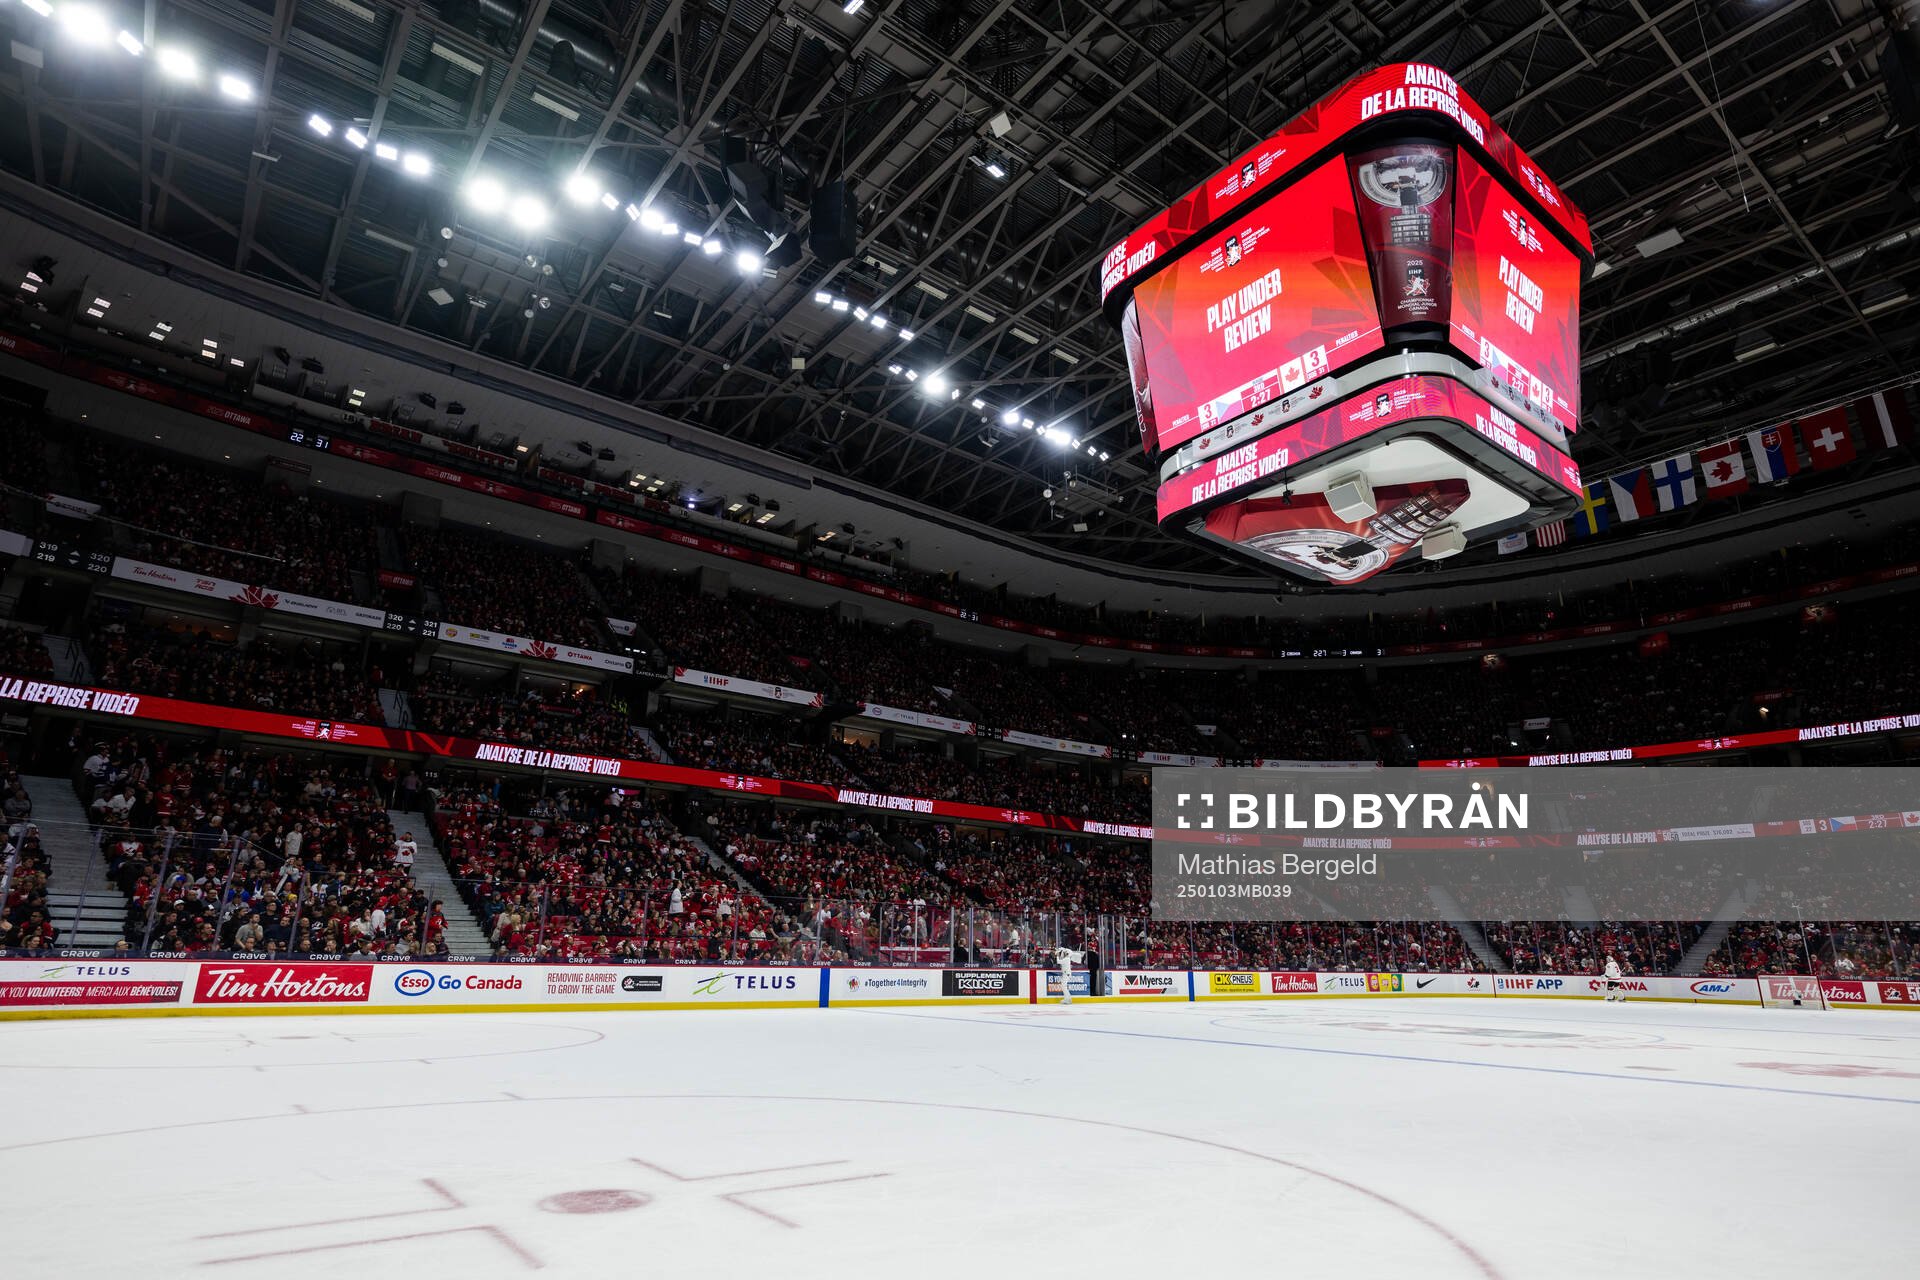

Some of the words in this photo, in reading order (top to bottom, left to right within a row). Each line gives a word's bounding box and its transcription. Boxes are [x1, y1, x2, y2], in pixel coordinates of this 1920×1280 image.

[1405, 64, 1459, 101] ANALYSE
[1361, 93, 1382, 120] DE
[1386, 88, 1406, 111] LA
[1409, 87, 1460, 122] REPRISE
[1460, 107, 1484, 145] VIDÉO
[1127, 240, 1156, 276] VIDÉO
[1499, 255, 1520, 292] PLAY
[1518, 271, 1543, 314] UNDER
[1207, 293, 1237, 333] PLAY
[1238, 268, 1282, 315] UNDER
[1506, 290, 1534, 335] REVIEW
[1224, 304, 1272, 353] REVIEW
[1310, 350, 1320, 368] 3
[1251, 389, 1272, 409] 2:27
[224, 410, 251, 426] OTTAWA
[1204, 403, 1213, 420] 3
[290, 433, 304, 443] 22
[315, 439, 329, 449] 31
[1215, 442, 1259, 477] ANALYSE
[1192, 484, 1204, 504] DE
[1205, 479, 1217, 500] LA
[1217, 461, 1258, 495] REPRISE
[1258, 447, 1289, 478] VIDÉO
[39, 541, 59, 552] 319
[36, 552, 56, 563] 219
[90, 552, 110, 563] 320
[87, 562, 108, 573] 220
[387, 612, 404, 622] 320
[423, 619, 438, 629] 321
[385, 622, 402, 632] 220
[421, 629, 437, 638] 221
[567, 651, 593, 661] OTTAWA
[708, 676, 729, 687] IIHF
[0, 677, 24, 700] LA
[22, 681, 94, 710] REPRISE
[92, 693, 140, 716] VIDÉO
[1799, 725, 1838, 741] ANALYSE
[1837, 722, 1850, 737] DE
[1850, 721, 1864, 735] LA
[1863, 715, 1902, 733] REPRISE
[475, 743, 525, 765] ANALYSE
[523, 749, 539, 766] DE
[537, 751, 552, 768] LA
[550, 753, 592, 773] REPRISE
[592, 758, 621, 777] VIDÉO
[1529, 754, 1560, 767] ANALYSE
[1559, 753, 1570, 765] DE
[1570, 752, 1580, 764] LA
[1579, 750, 1611, 763] REPRISE
[1610, 747, 1633, 761] VIDÉO
[838, 789, 869, 806] ANALYSE
[868, 793, 879, 807] DE
[878, 794, 888, 808] LA
[887, 796, 914, 811] REPRISE
[914, 799, 934, 814] VIDÉO
[1083, 820, 1105, 834] ANALYSE
[1818, 819, 1828, 831] 3
[1868, 819, 1887, 830] 2:27
[1303, 837, 1329, 848] ANALYSE
[1329, 838, 1338, 848] DE
[1346, 838, 1372, 849] REPRISE
[1576, 833, 1611, 846] ANALYSE
[1611, 832, 1622, 845] DE
[1622, 832, 1633, 844] LA
[1632, 831, 1657, 844] REPRI
[76, 966, 131, 976] TELUS
[547, 972, 584, 983] REMOVING
[584, 973, 617, 983] BARRIERS
[955, 972, 1007, 980] SUPPLEMENT
[206, 968, 258, 998] Tim
[261, 967, 366, 998] Hortons
[401, 975, 429, 988] Esso
[438, 975, 461, 990] Go
[465, 975, 522, 990] Canada
[734, 975, 796, 990] TELUS
[864, 978, 928, 989] #Together4Integrity
[958, 980, 1004, 990] KING
[1139, 974, 1173, 988] Myers.ca
[1215, 974, 1231, 985] OK
[1232, 975, 1253, 984] PNEUS
[1273, 976, 1289, 991] Tim
[1289, 975, 1318, 991] Hortons
[1339, 977, 1365, 987] TELUS
[1505, 979, 1534, 990] IIHF
[1536, 979, 1563, 990] APP
[9, 987, 27, 998] YOU
[27, 986, 84, 998] VOLUNTEERS!
[86, 985, 114, 997] MERCI
[113, 985, 131, 996] AUX
[130, 984, 178, 997] BÉNÉVOLES!
[547, 984, 557, 994] TO
[557, 984, 580, 994] GROW
[581, 984, 594, 994] THE
[595, 984, 616, 994] GAME
[1699, 984, 1730, 993] AMJ
